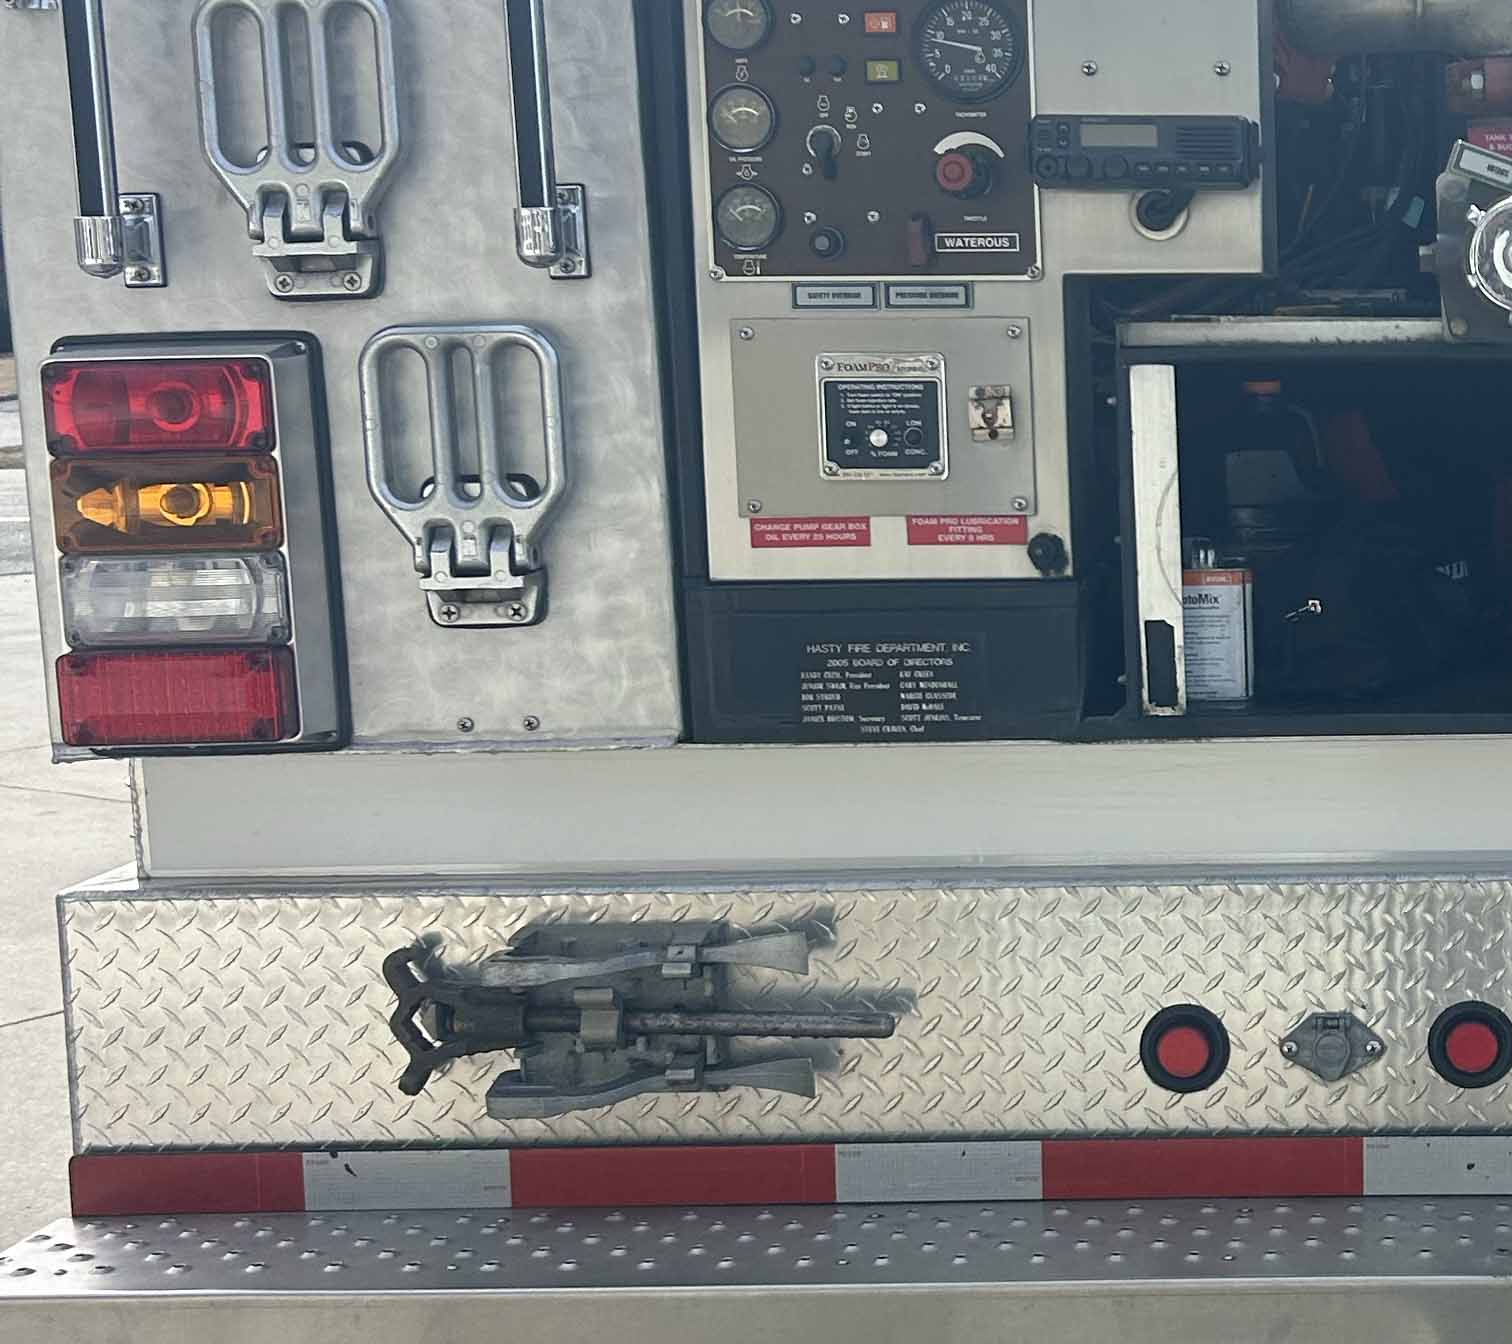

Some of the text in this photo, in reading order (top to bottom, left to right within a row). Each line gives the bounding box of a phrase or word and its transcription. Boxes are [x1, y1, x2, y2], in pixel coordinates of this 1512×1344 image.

[961, 10, 972, 20] 20
[979, 16, 990, 26] 25
[990, 30, 1001, 40] 30
[992, 48, 1003, 58] 35
[944, 63, 951, 74] 0
[985, 63, 997, 73] 40
[1484, 134, 1505, 142] TANK
[945, 238, 1010, 248] WATEROUS
[847, 522, 867, 530] BOX
[960, 517, 1019, 525] LUBRICATION
[938, 534, 966, 542] EVERY
[1183, 594, 1219, 605] otoMix
[806, 643, 842, 654] HASTY
[847, 643, 872, 653] FIRE
[875, 643, 946, 653] DEPARTMENT
[852, 659, 884, 667] BOARD
[887, 658, 899, 666] OF
[903, 658, 954, 666] DIRECTORS
